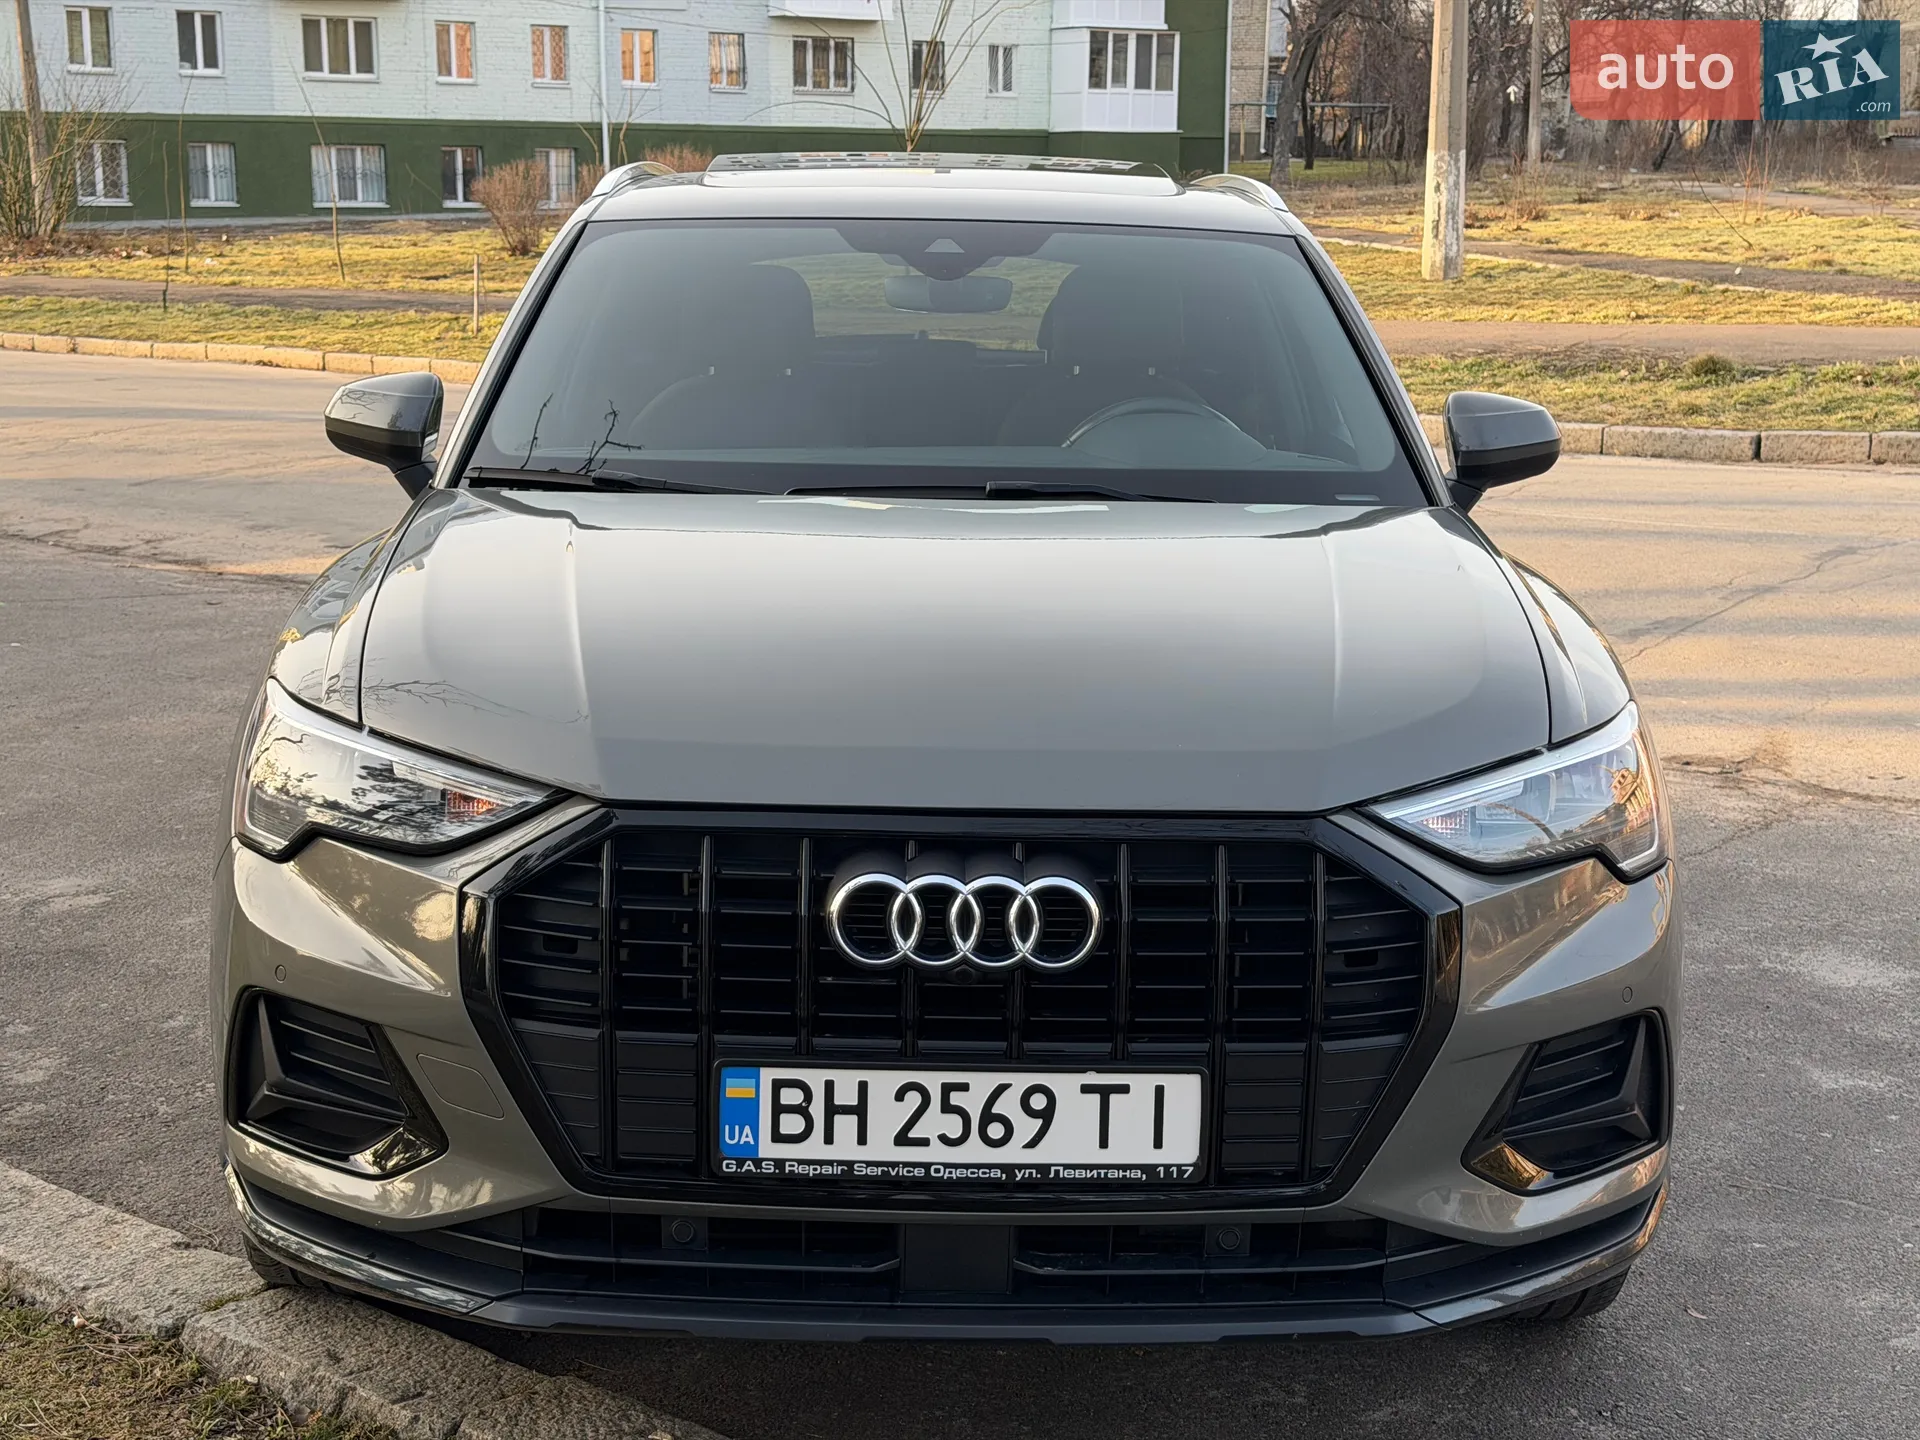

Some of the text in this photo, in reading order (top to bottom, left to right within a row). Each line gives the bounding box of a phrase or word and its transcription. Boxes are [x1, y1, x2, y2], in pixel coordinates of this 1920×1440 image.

[770, 1077, 868, 1146] BH
[893, 1080, 1057, 1149] 2569
[724, 1125, 754, 1145] UA
[722, 1160, 1194, 1180] G.A.S. Repair Service Одесса, ул. Левитана, 117
